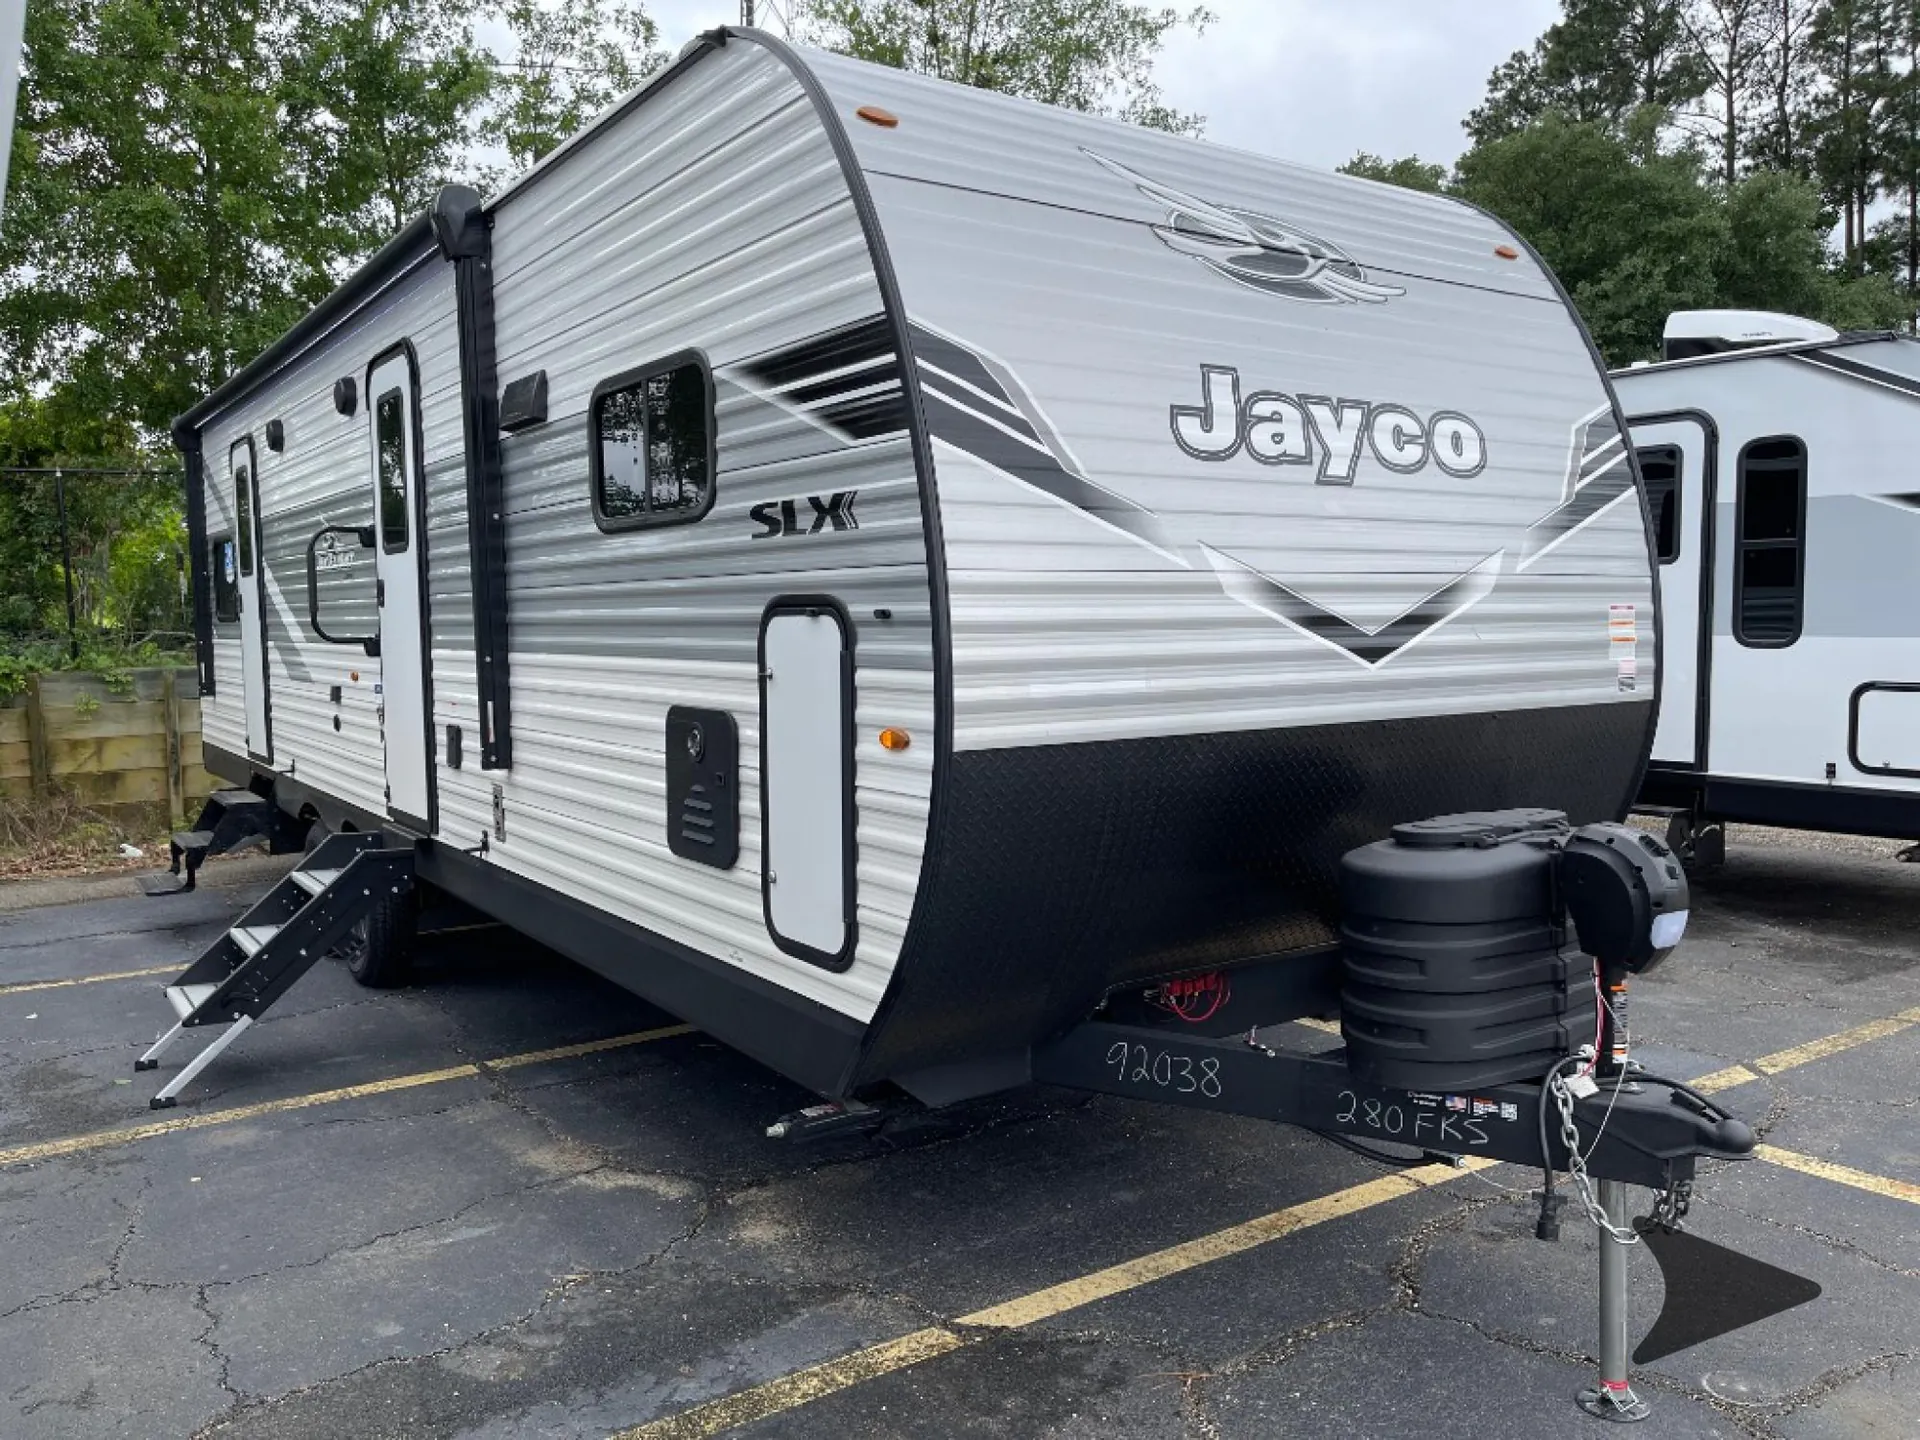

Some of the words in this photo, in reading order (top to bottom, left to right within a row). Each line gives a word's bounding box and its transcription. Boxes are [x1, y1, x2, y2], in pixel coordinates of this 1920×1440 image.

[1170, 363, 1488, 487] Jayco
[749, 490, 860, 540] SLX
[1105, 1041, 1222, 1098] 92038
